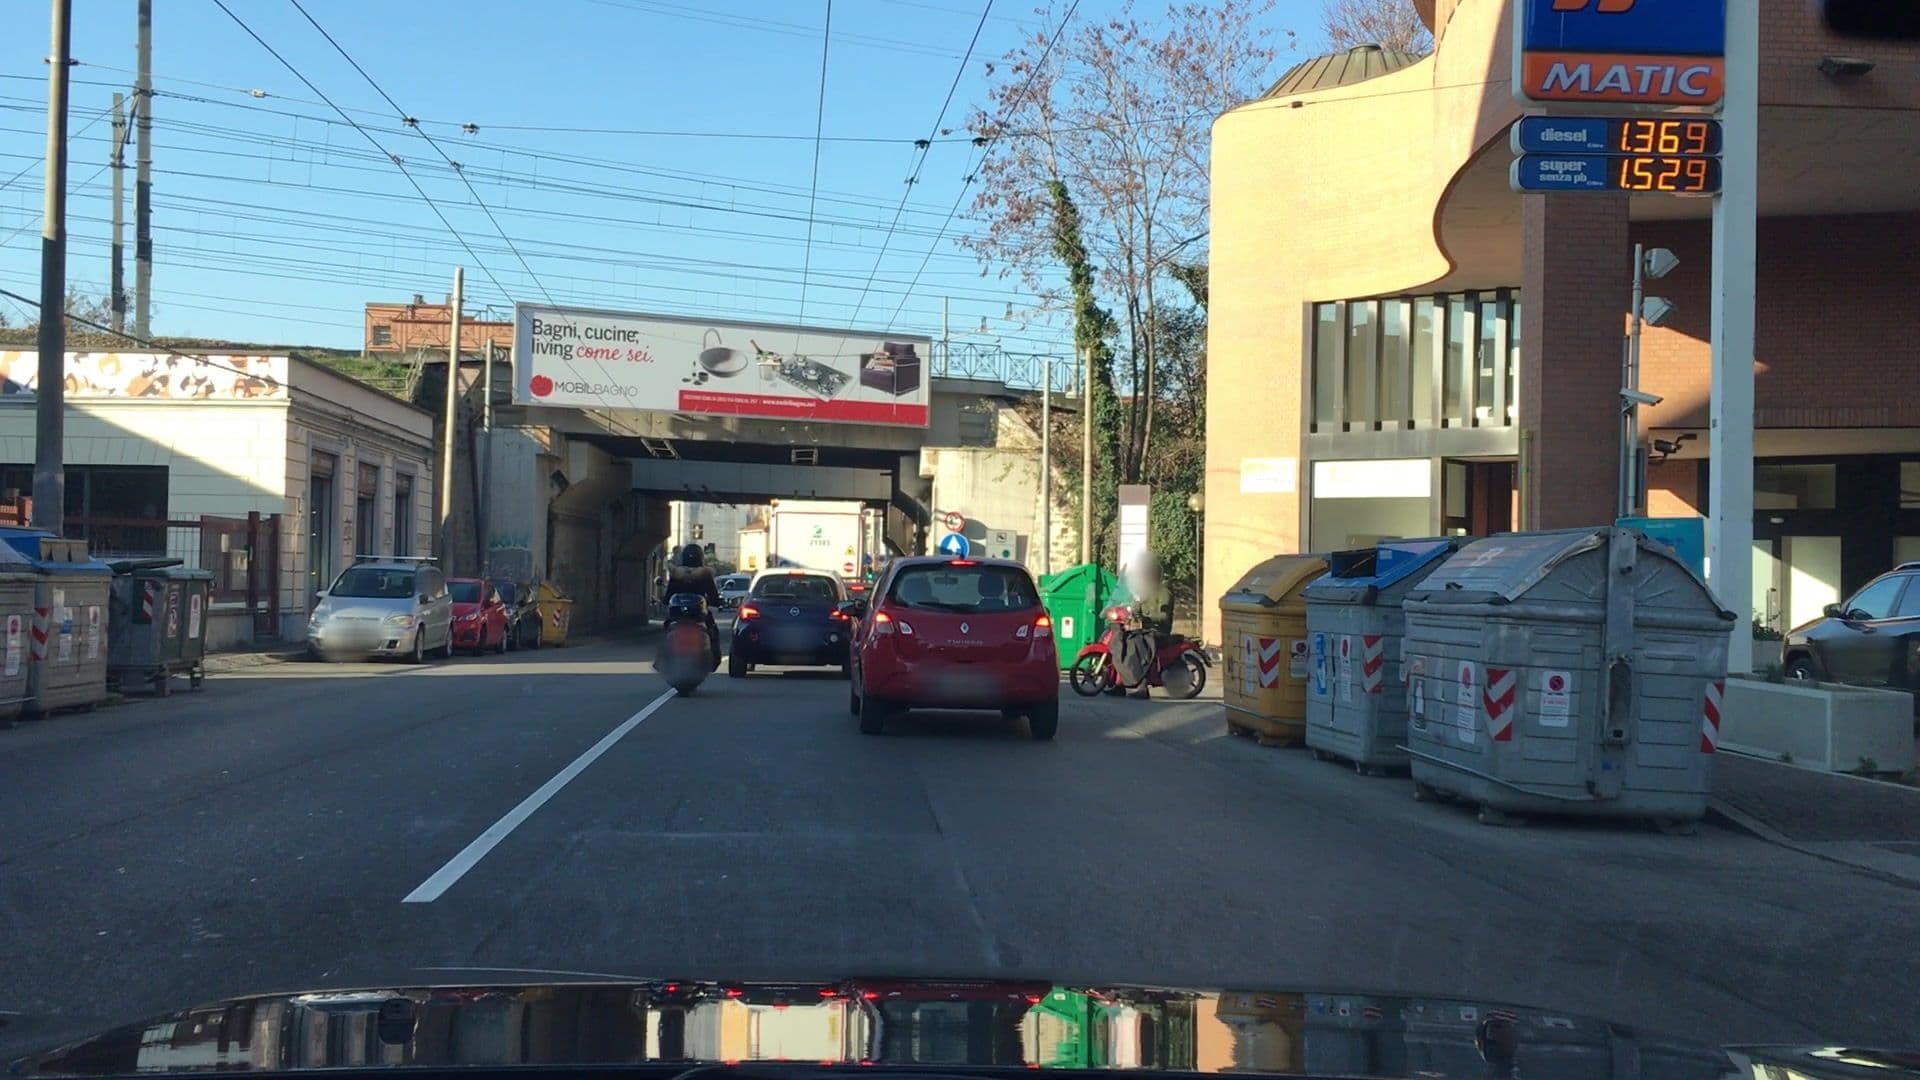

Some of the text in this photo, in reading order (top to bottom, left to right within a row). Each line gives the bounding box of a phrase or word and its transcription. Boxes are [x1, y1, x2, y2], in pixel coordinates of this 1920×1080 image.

[1541, 62, 1711, 97] MATIC
[1540, 127, 1588, 142] diesel
[1621, 121, 1707, 153] 1.369
[1539, 160, 1587, 174] super
[1539, 173, 1572, 182] senza
[1573, 172, 1588, 184] pb
[1620, 158, 1707, 190] 1.529
[532, 319, 640, 344] Bagni, cucine,
[531, 337, 655, 363] living come sei.
[554, 381, 639, 397] MOBILBAGNO
